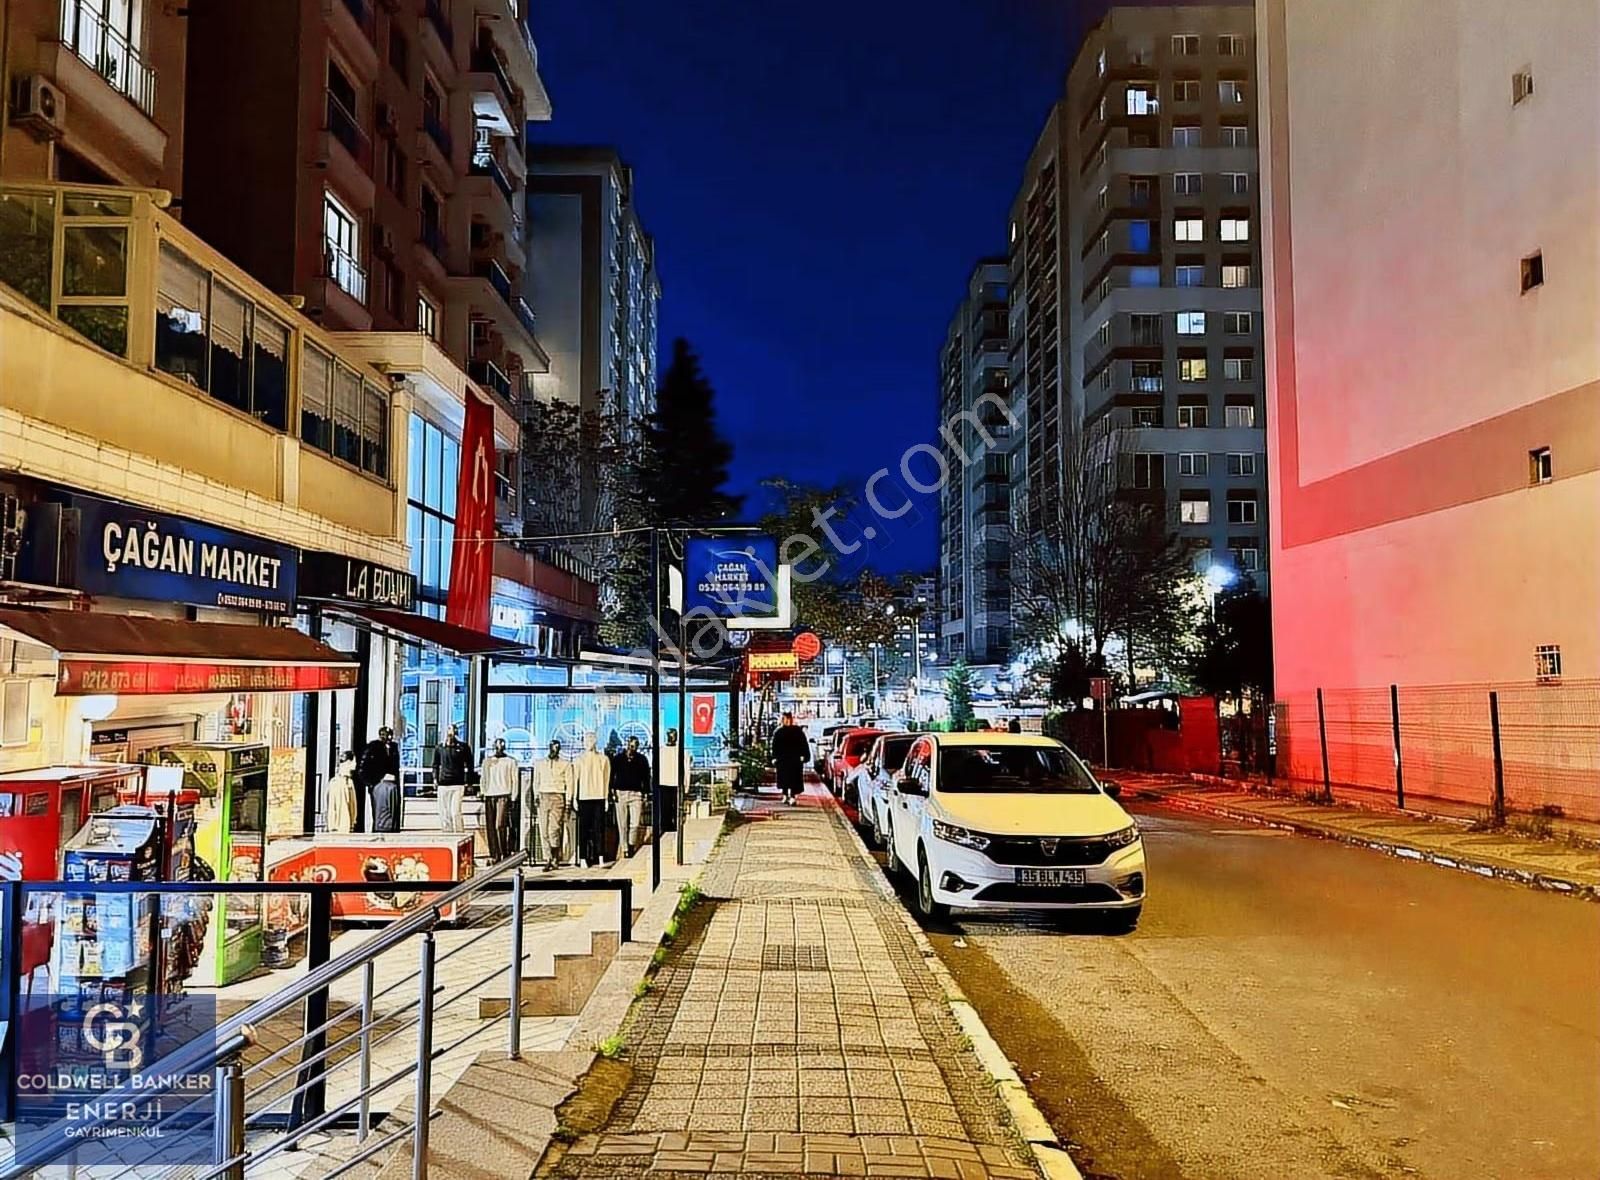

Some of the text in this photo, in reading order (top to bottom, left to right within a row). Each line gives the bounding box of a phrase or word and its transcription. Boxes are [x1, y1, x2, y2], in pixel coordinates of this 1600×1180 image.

[103, 521, 281, 589] ÇAĞAN MARKET
[346, 560, 368, 600] LA
[714, 573, 749, 582] MARKET
[81, 670, 109, 689] 0212
